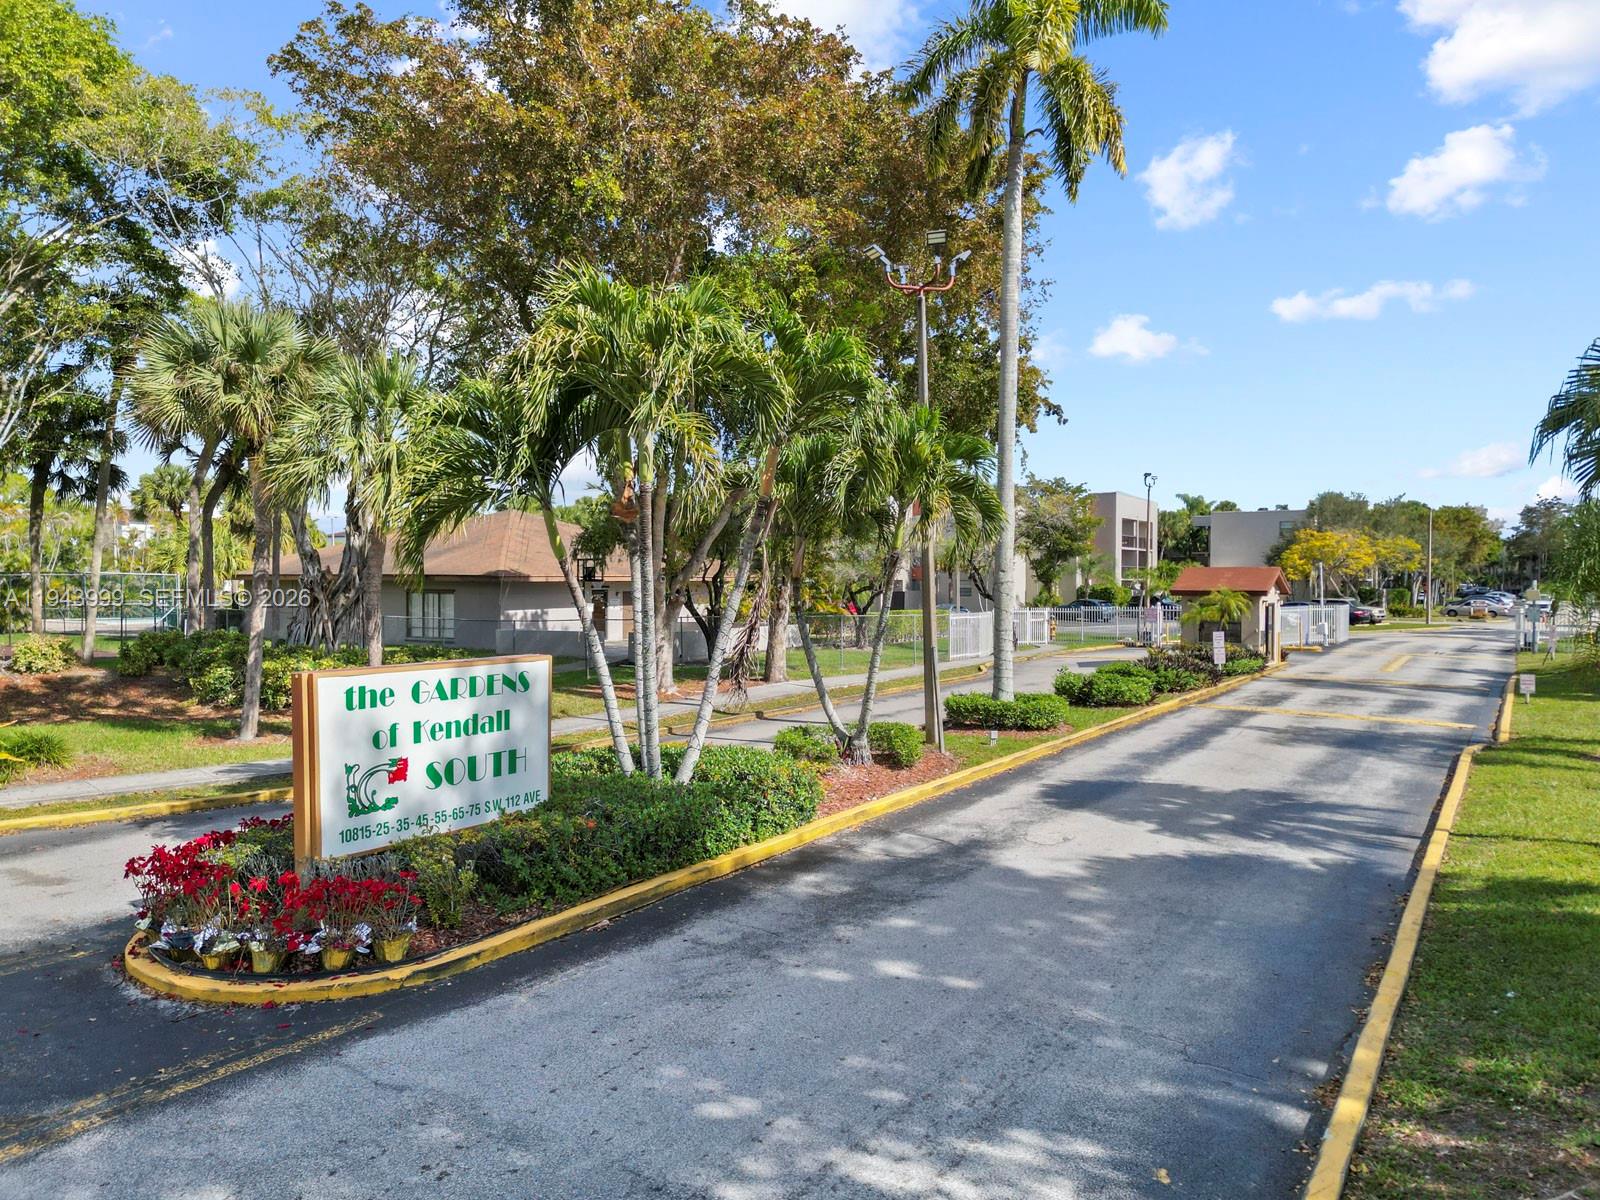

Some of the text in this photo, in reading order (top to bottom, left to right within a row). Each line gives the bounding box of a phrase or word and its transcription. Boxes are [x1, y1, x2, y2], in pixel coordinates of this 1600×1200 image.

[343, 670, 530, 711] the GARDENS
[372, 709, 511, 750] of Kendall
[425, 747, 527, 790] SOUTH
[505, 793, 521, 808] 112
[523, 789, 542, 804] AVE
